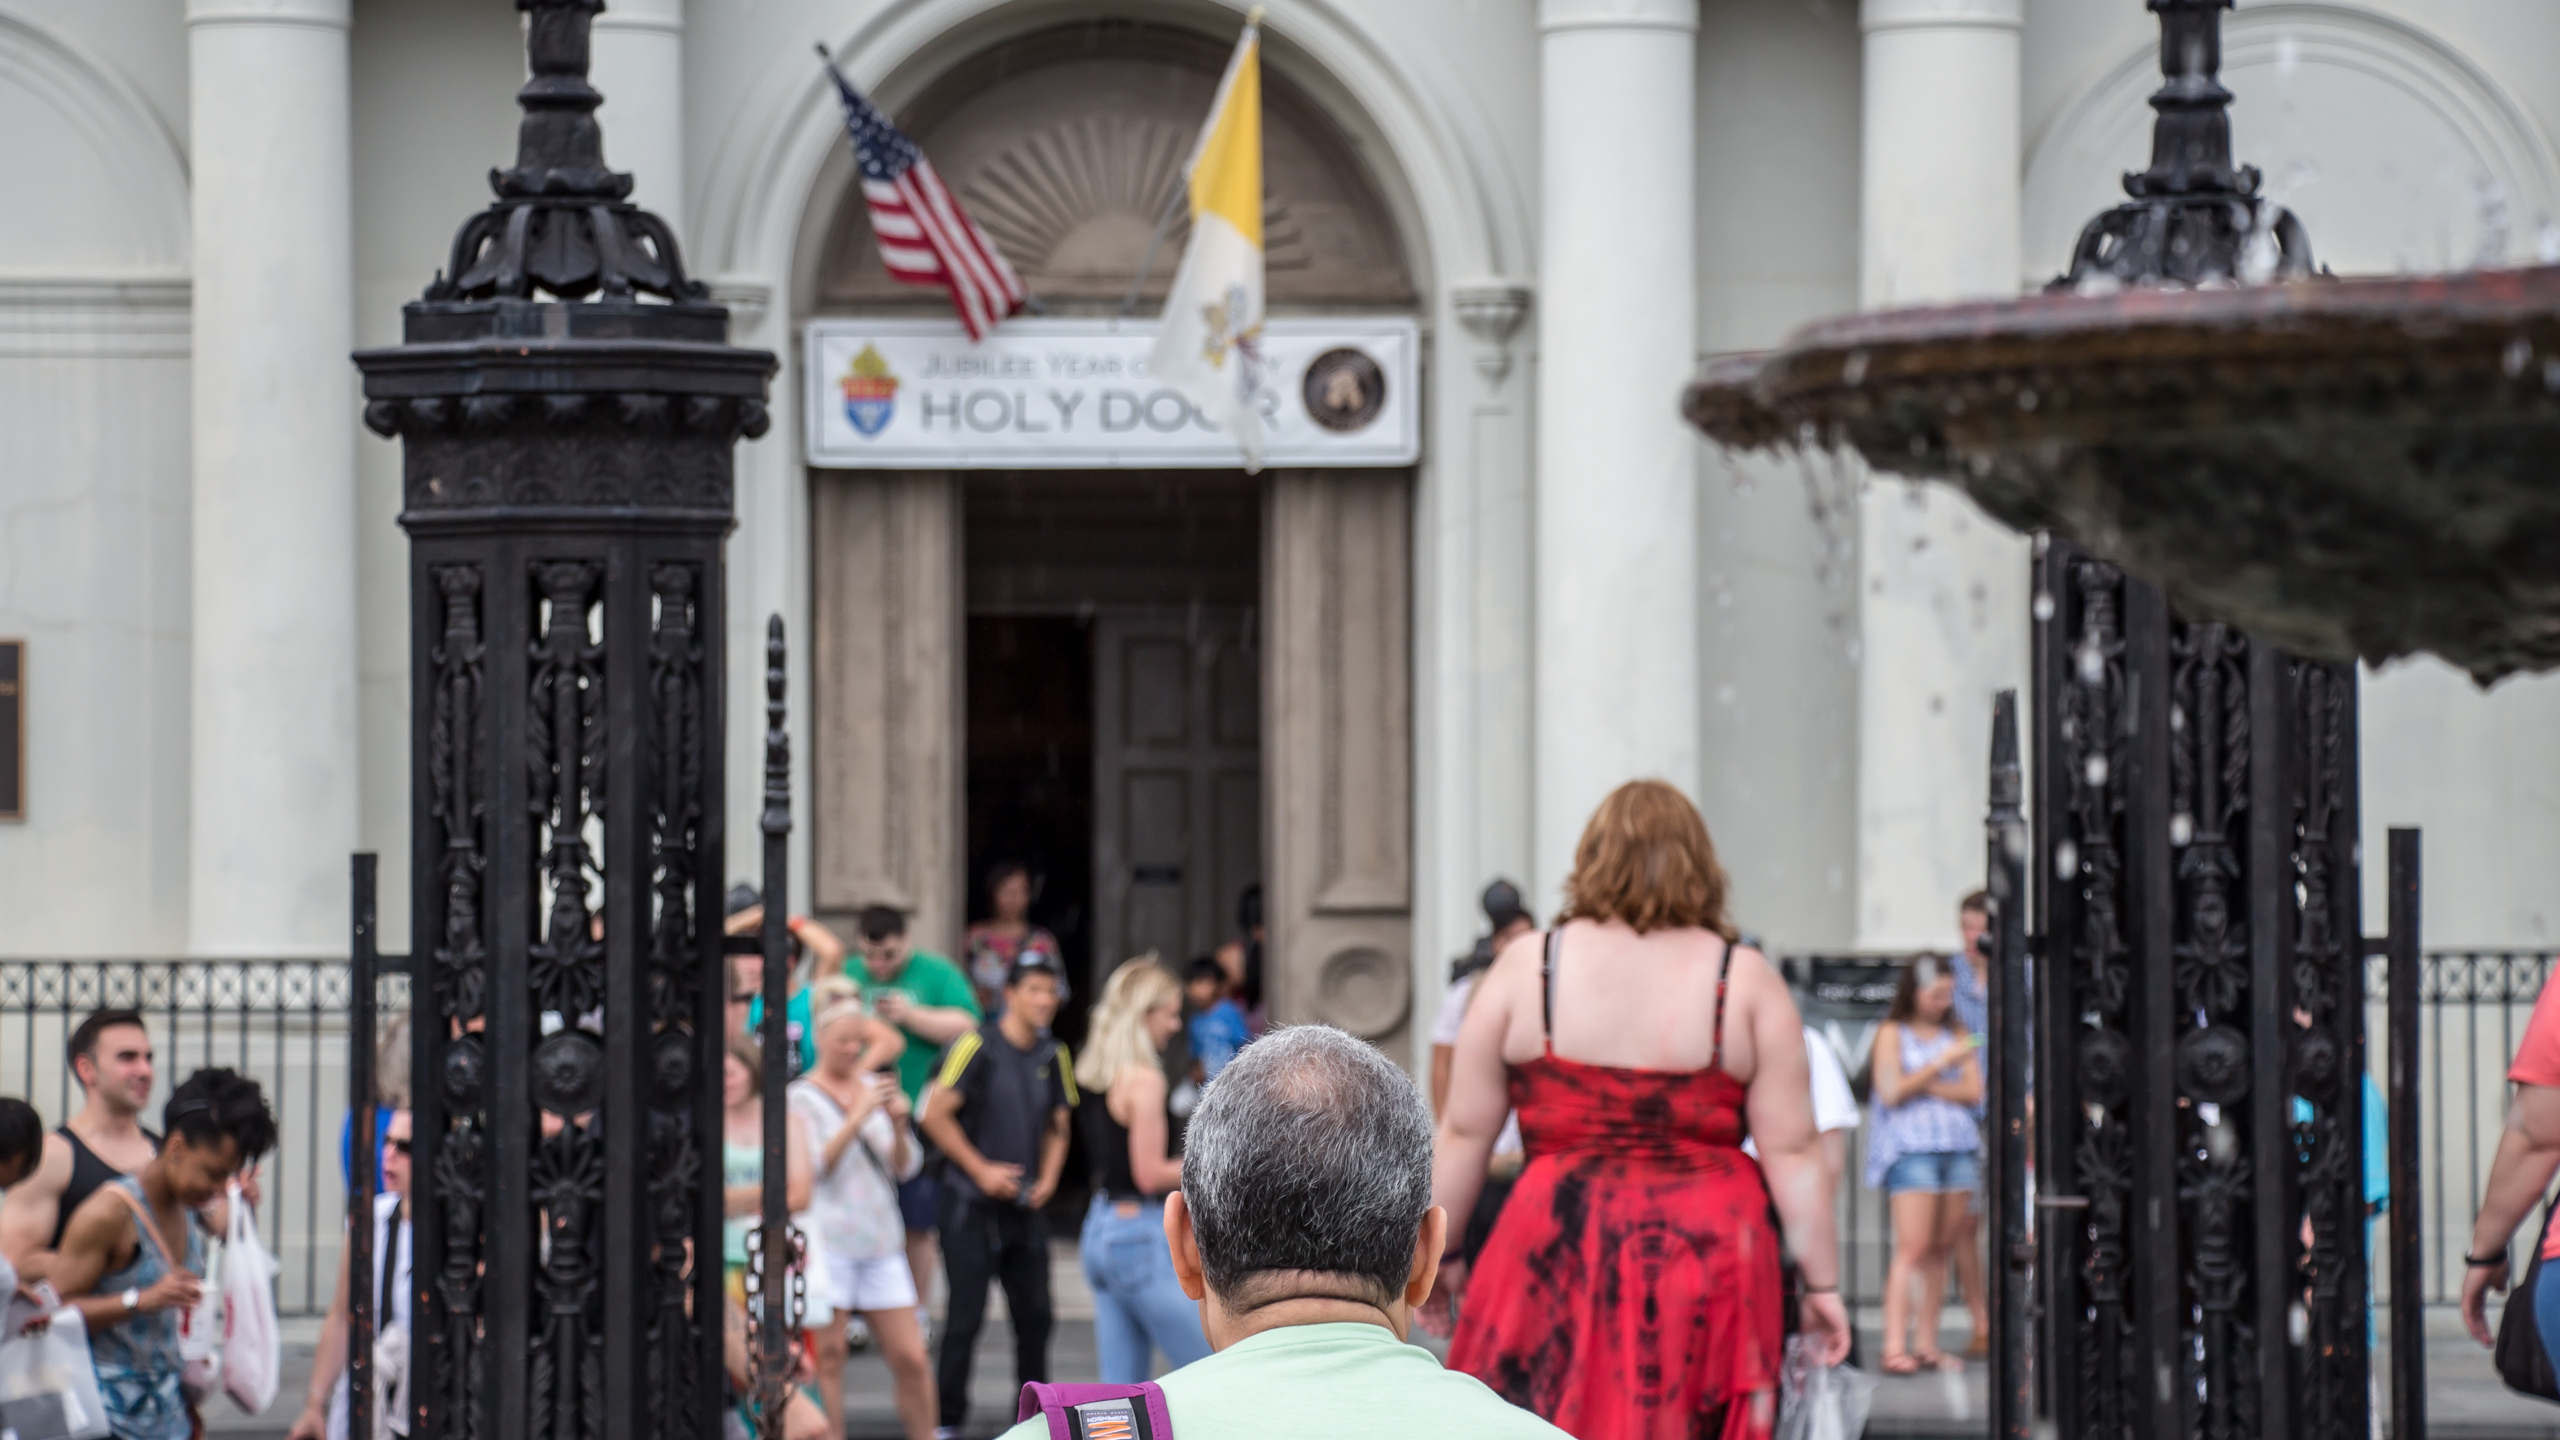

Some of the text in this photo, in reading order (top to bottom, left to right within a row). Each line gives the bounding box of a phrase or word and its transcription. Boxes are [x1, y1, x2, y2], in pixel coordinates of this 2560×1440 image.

[919, 354, 1038, 379] JUBILEE
[1046, 354, 1124, 379] YEAR
[922, 389, 1085, 432] HOLY
